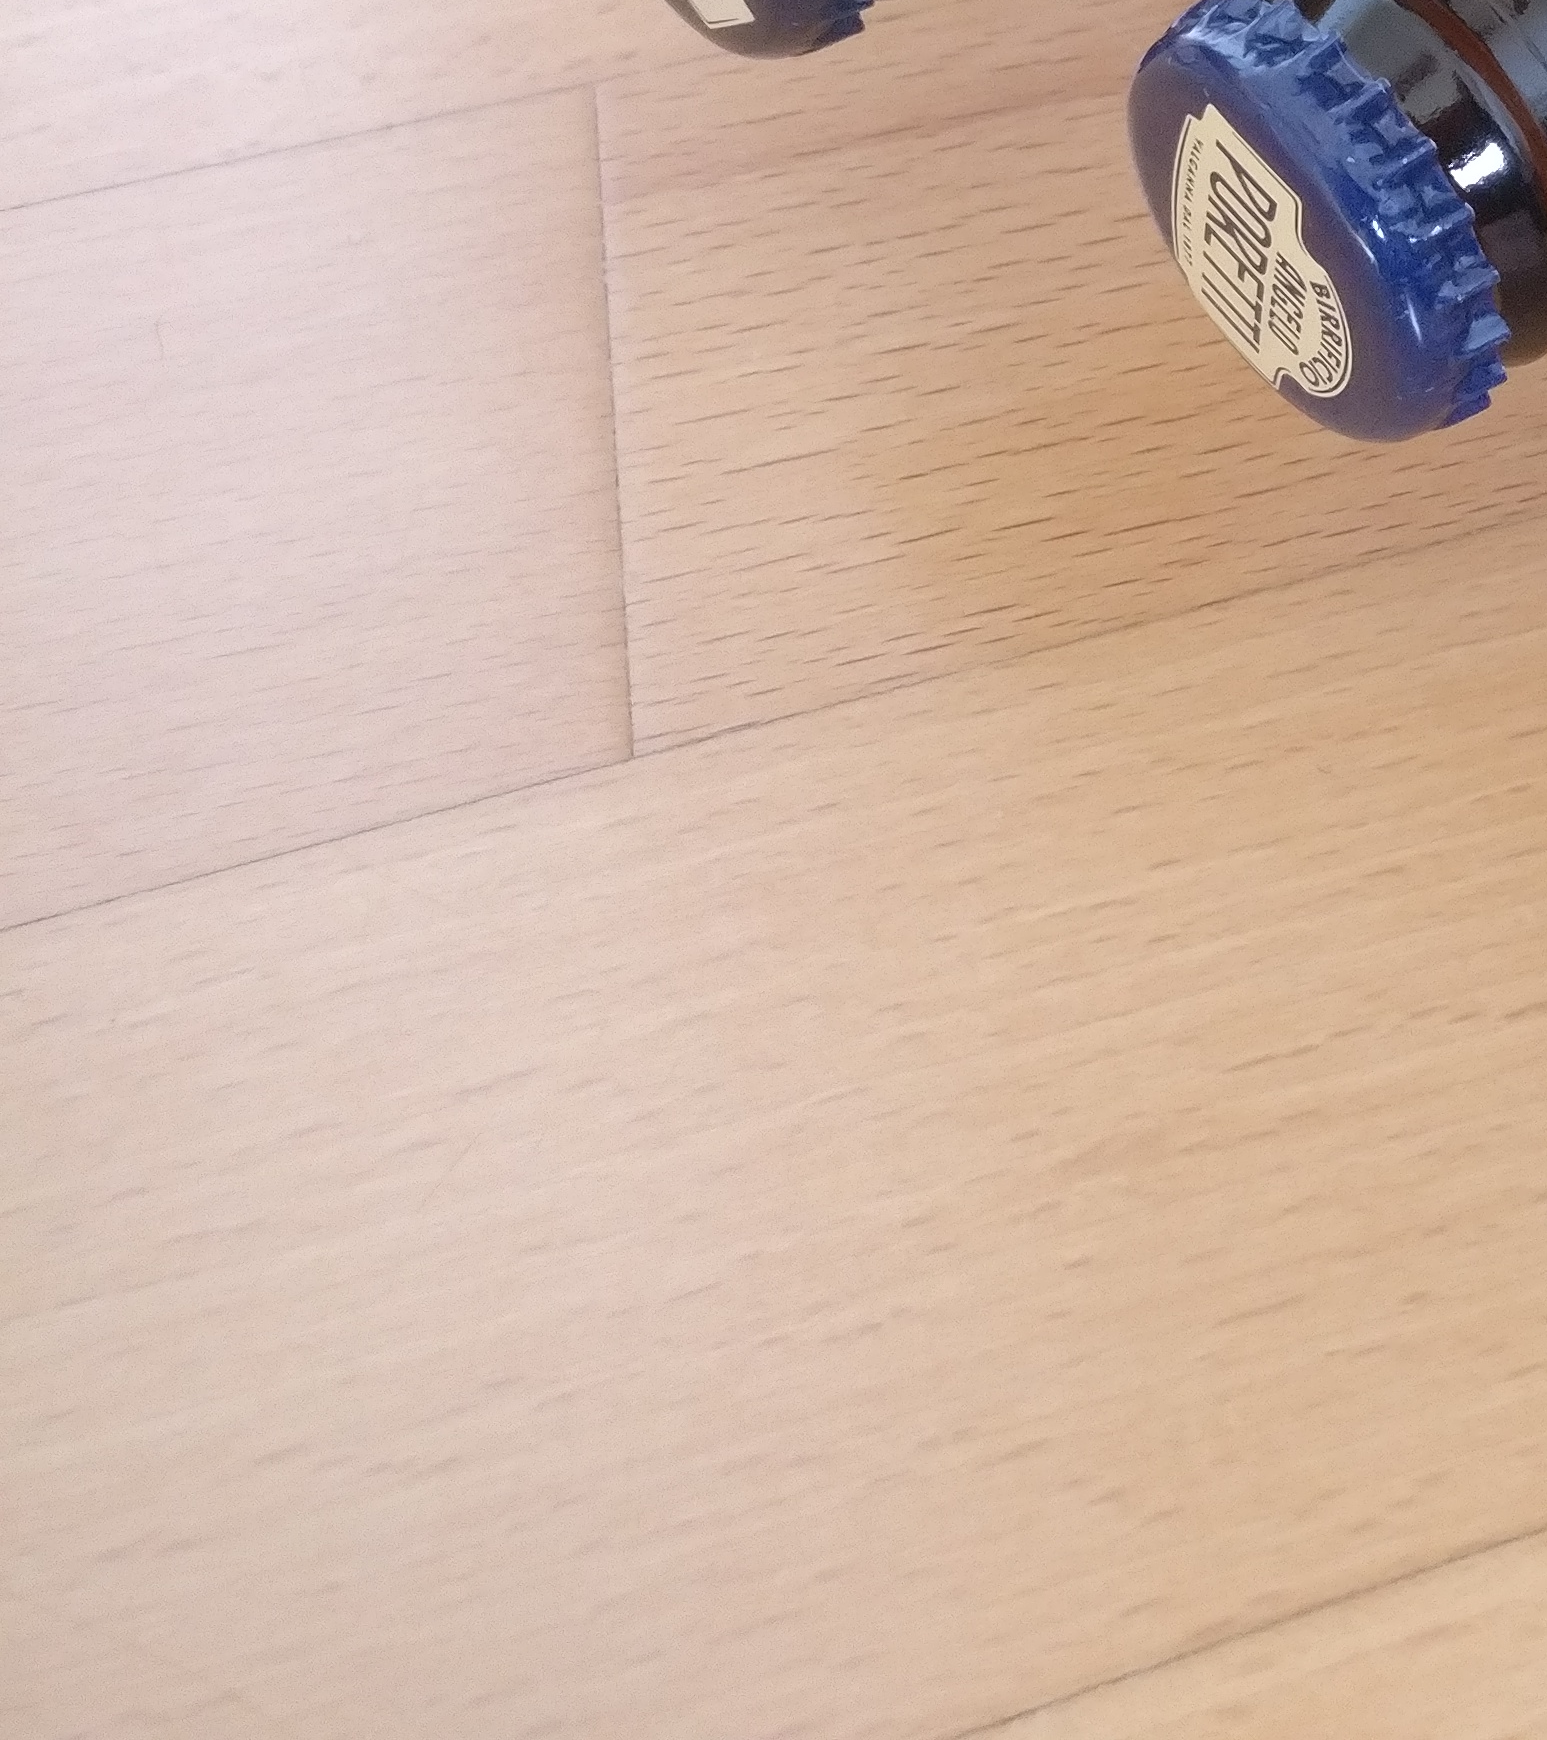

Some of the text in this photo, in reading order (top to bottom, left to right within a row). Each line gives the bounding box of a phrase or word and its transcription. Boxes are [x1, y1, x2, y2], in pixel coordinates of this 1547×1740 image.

[1201, 139, 1278, 353] PORETTI
[1268, 251, 1307, 356] ANGELO
[1299, 281, 1343, 387] BIRRIFICIO
